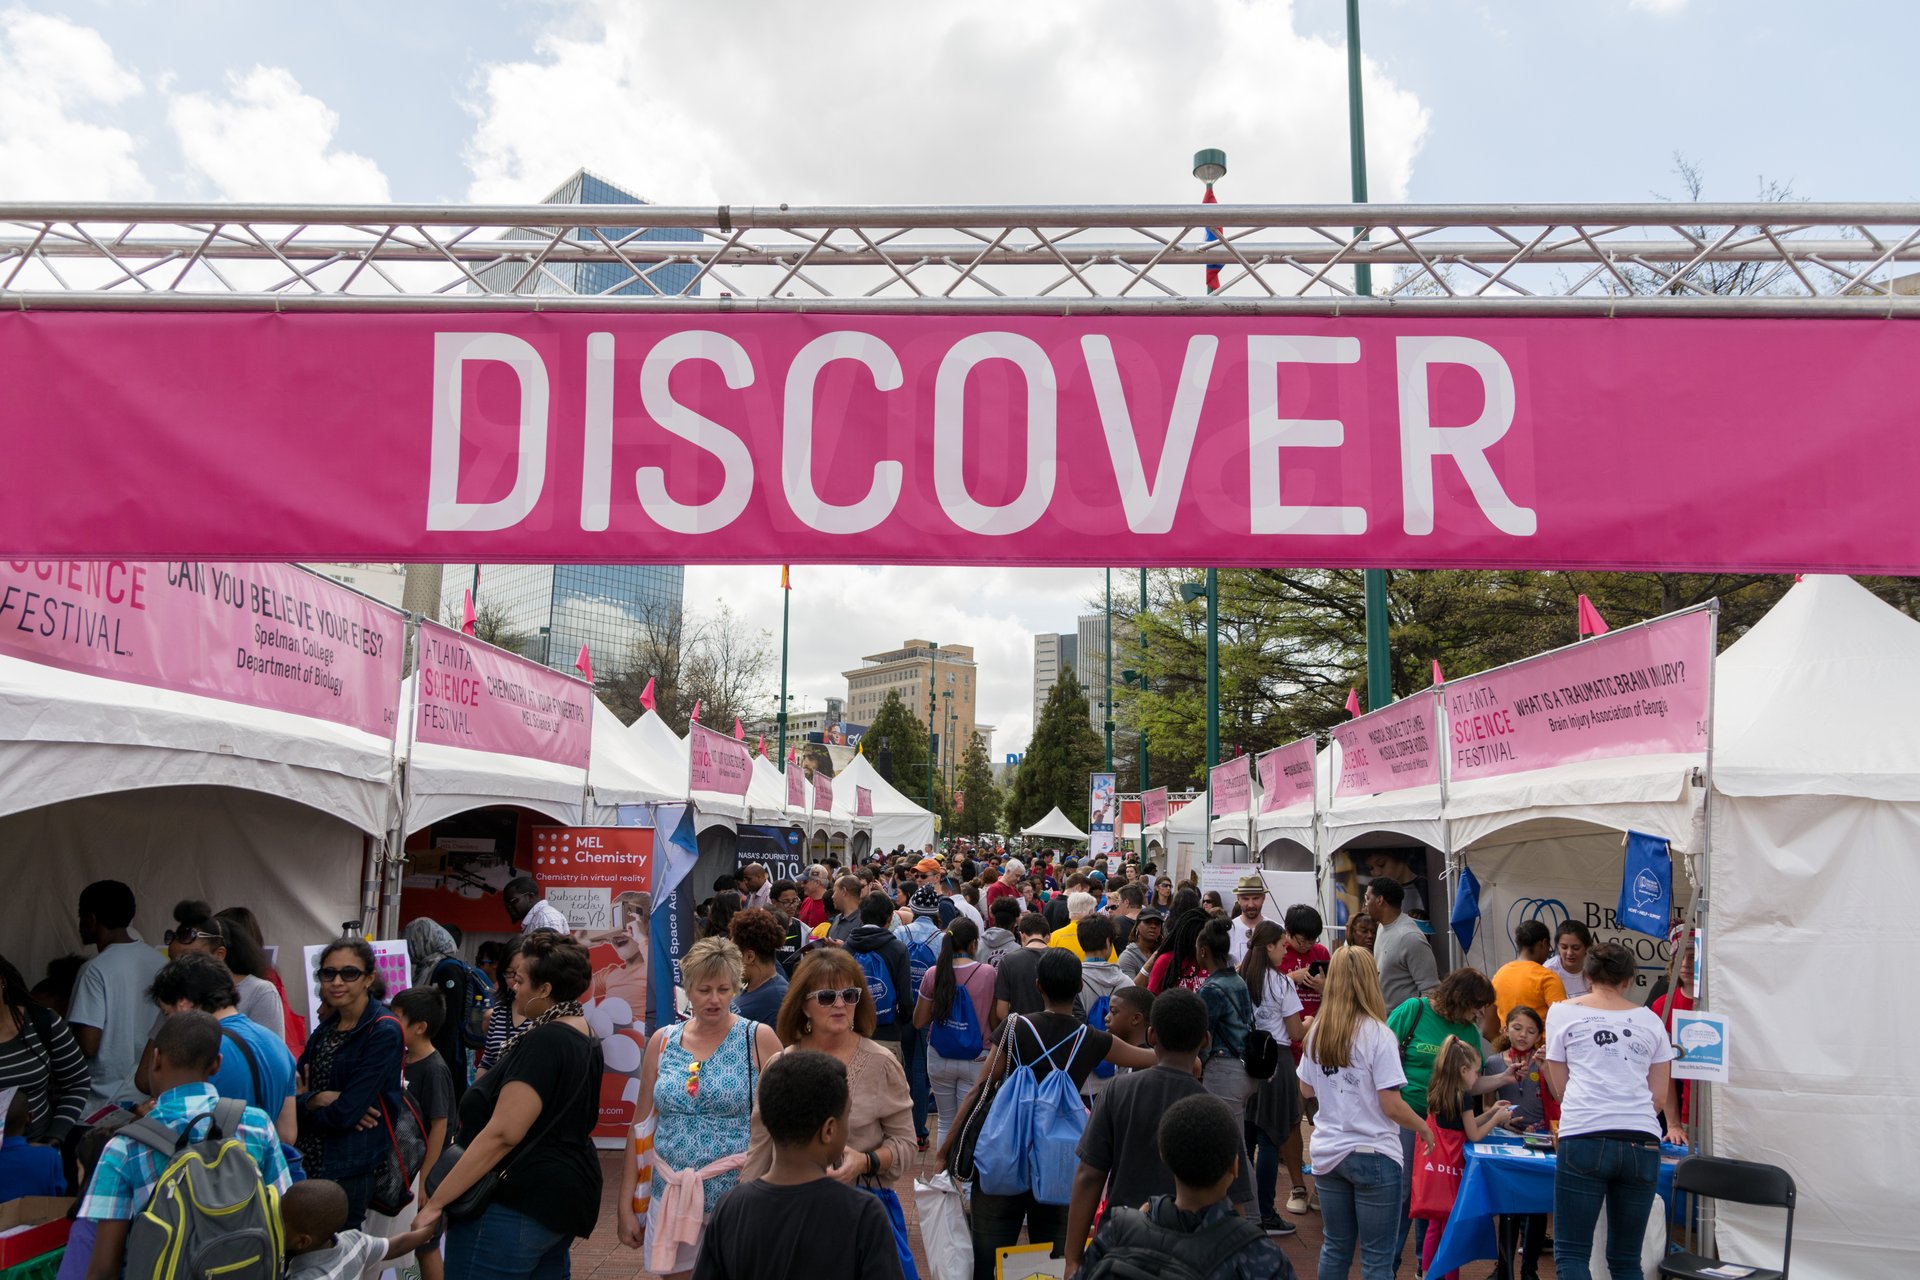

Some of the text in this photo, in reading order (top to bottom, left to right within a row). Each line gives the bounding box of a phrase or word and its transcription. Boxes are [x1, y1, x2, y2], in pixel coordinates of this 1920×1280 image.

[427, 330, 1537, 536] DISCOVER
[9, 561, 146, 610] IENCE
[0, 586, 125, 655] FESTIVAL
[167, 562, 383, 658] CAN YOU BELIEVE YOUR EYES?
[255, 623, 334, 667] Spelman College
[426, 639, 473, 672] ATLANTA
[237, 648, 344, 697] Department of Biology
[425, 668, 480, 707] SCIENCE
[487, 676, 527, 705] CHEMISTRY
[1453, 686, 1498, 715] ATLANTA
[1513, 695, 1543, 717] WHAT
[1543, 693, 1554, 710] IS
[1554, 691, 1562, 707] A
[1560, 677, 1618, 704] TRAUMATIC
[1614, 669, 1649, 694] BRAIN
[424, 704, 470, 735] FESTIVAL
[1455, 709, 1515, 744] SCIENCE
[1548, 696, 1668, 732] Brain Injury Association of Georgia
[1458, 741, 1516, 769] FESTIVAL
[576, 836, 604, 848] MEL
[575, 851, 647, 867] Chemistry
[536, 873, 646, 883] Chemistry in virtual reality
[549, 889, 600, 901] Subscribe
[571, 900, 604, 911] today
[588, 910, 606, 927] VR
[670, 913, 680, 954] Space
[671, 959, 681, 983] and
